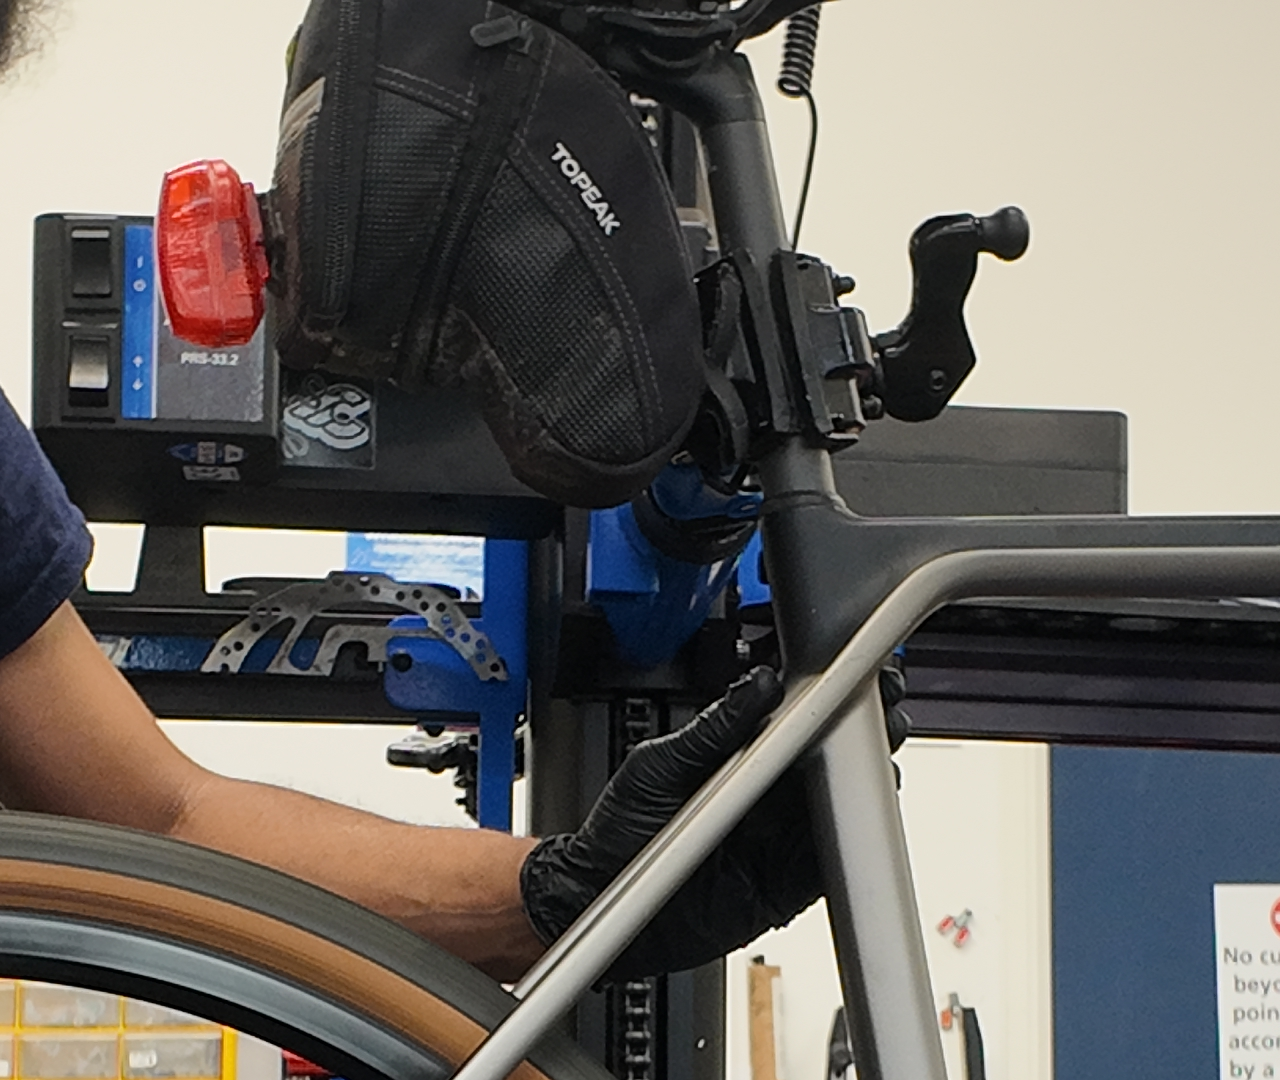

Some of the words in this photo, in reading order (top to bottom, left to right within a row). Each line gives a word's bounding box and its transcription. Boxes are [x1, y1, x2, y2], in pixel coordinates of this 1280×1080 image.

[551, 142, 620, 236] TOPEAK
[1223, 947, 1253, 965] No
[1262, 1063, 1275, 1078] a
